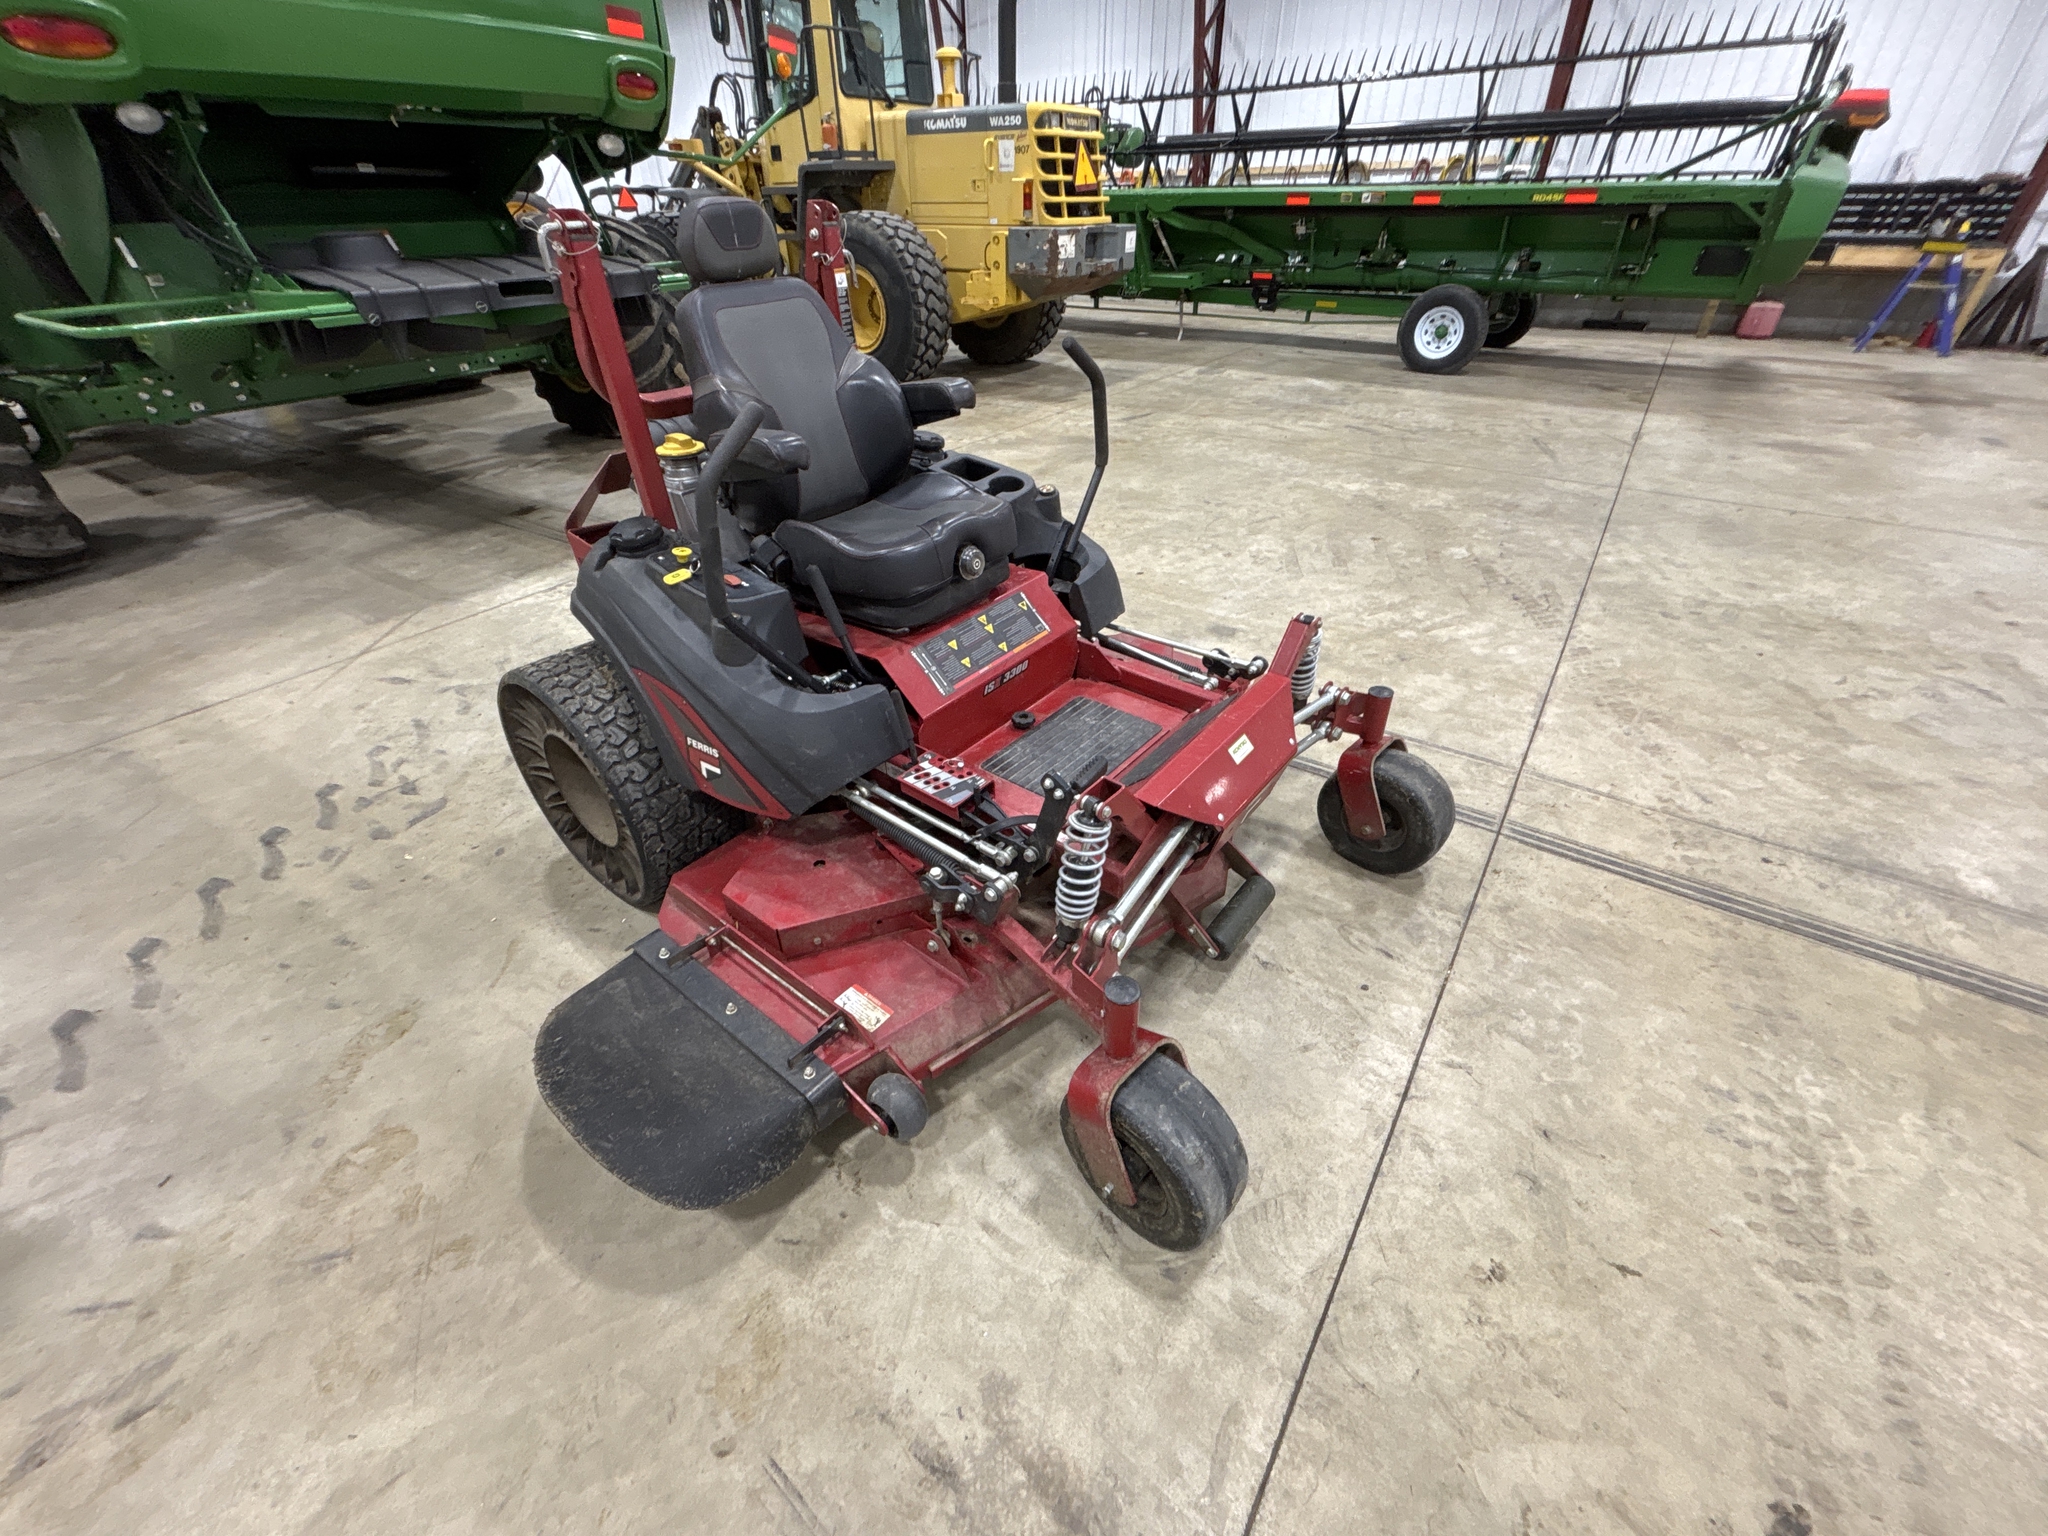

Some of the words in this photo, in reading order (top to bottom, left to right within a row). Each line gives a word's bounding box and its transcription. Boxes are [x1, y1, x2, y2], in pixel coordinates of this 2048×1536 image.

[923, 114, 967, 130] KOMATSU
[989, 114, 1022, 127] WA250
[1002, 659, 1029, 684] 3300
[686, 736, 719, 758] FERRIS
